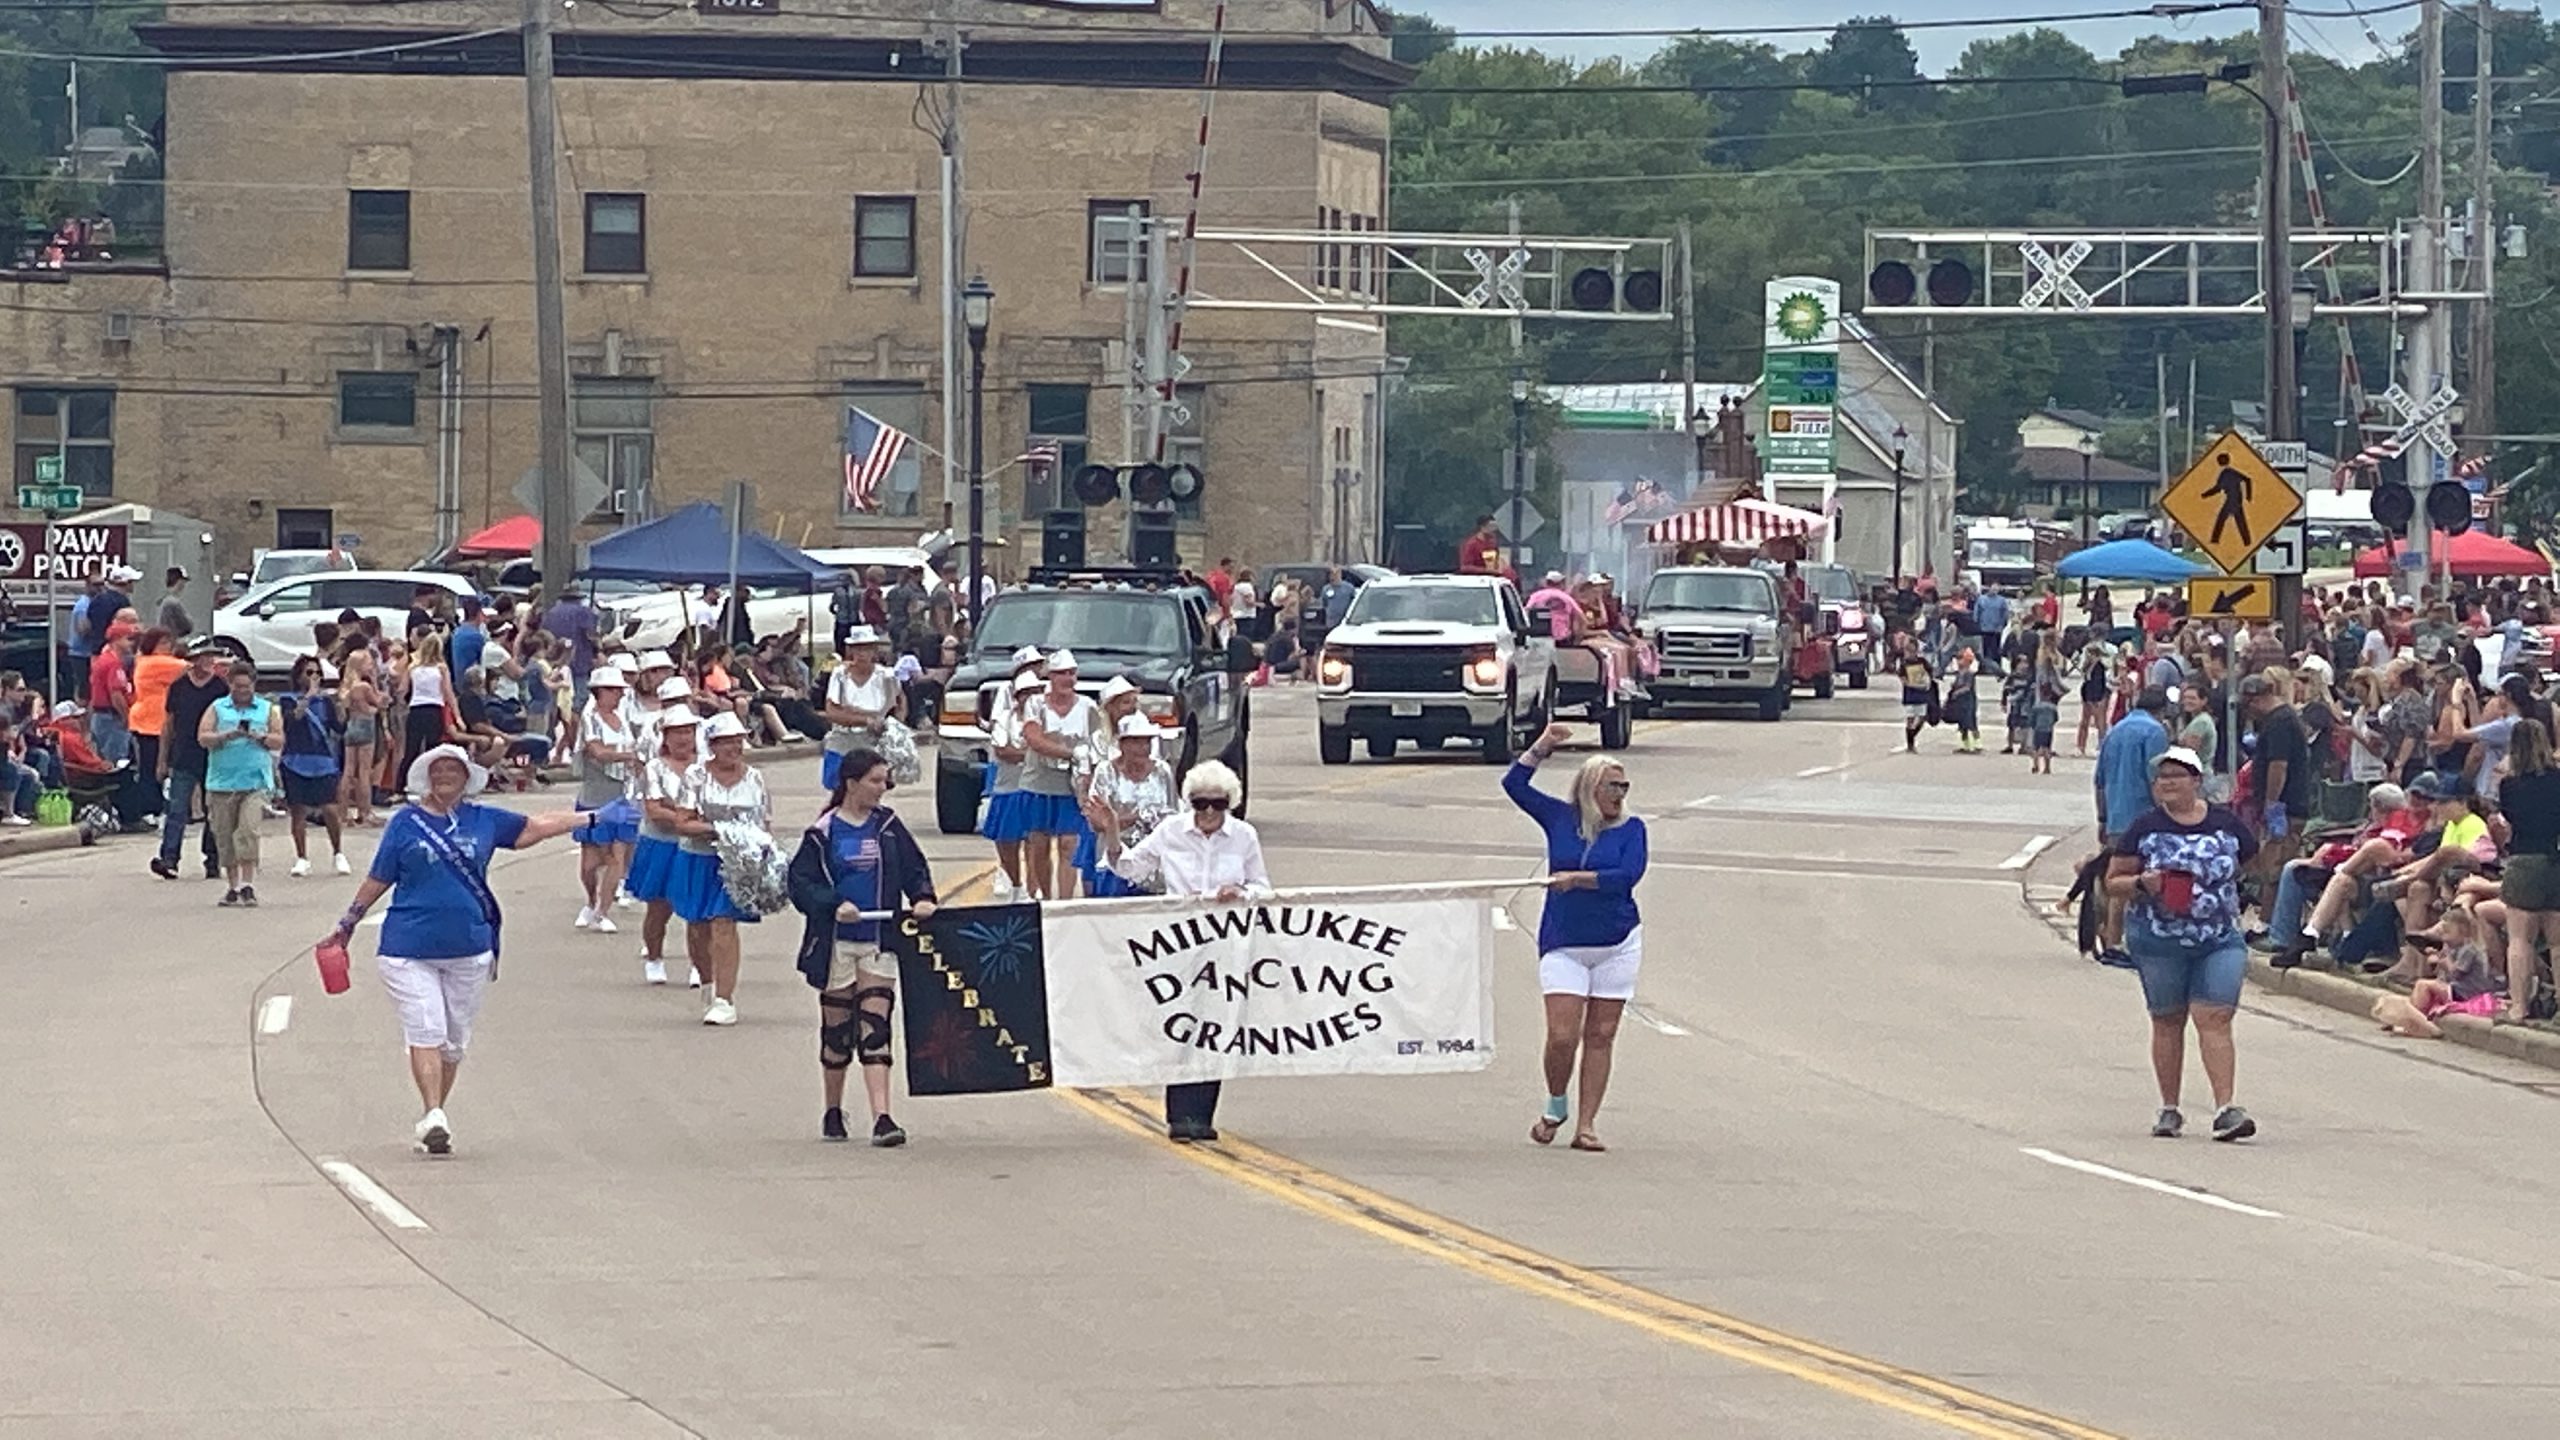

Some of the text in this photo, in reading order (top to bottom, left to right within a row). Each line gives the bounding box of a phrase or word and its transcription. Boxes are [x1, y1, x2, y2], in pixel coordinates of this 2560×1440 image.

[2022, 241, 2090, 310] RAIL ROAD
[2390, 387, 2414, 417] RAIL
[2425, 424, 2454, 456] ROAD
[33, 553, 121, 579] PATCH
[45, 527, 110, 553] PAW
[1127, 906, 1406, 967] MILWAUKEE
[901, 918, 1046, 1082] CELEBRATE
[1144, 958, 1394, 1006] DANCING
[1163, 1002, 1382, 1056] GRANNIES
[1437, 1039, 1474, 1054] 1984
